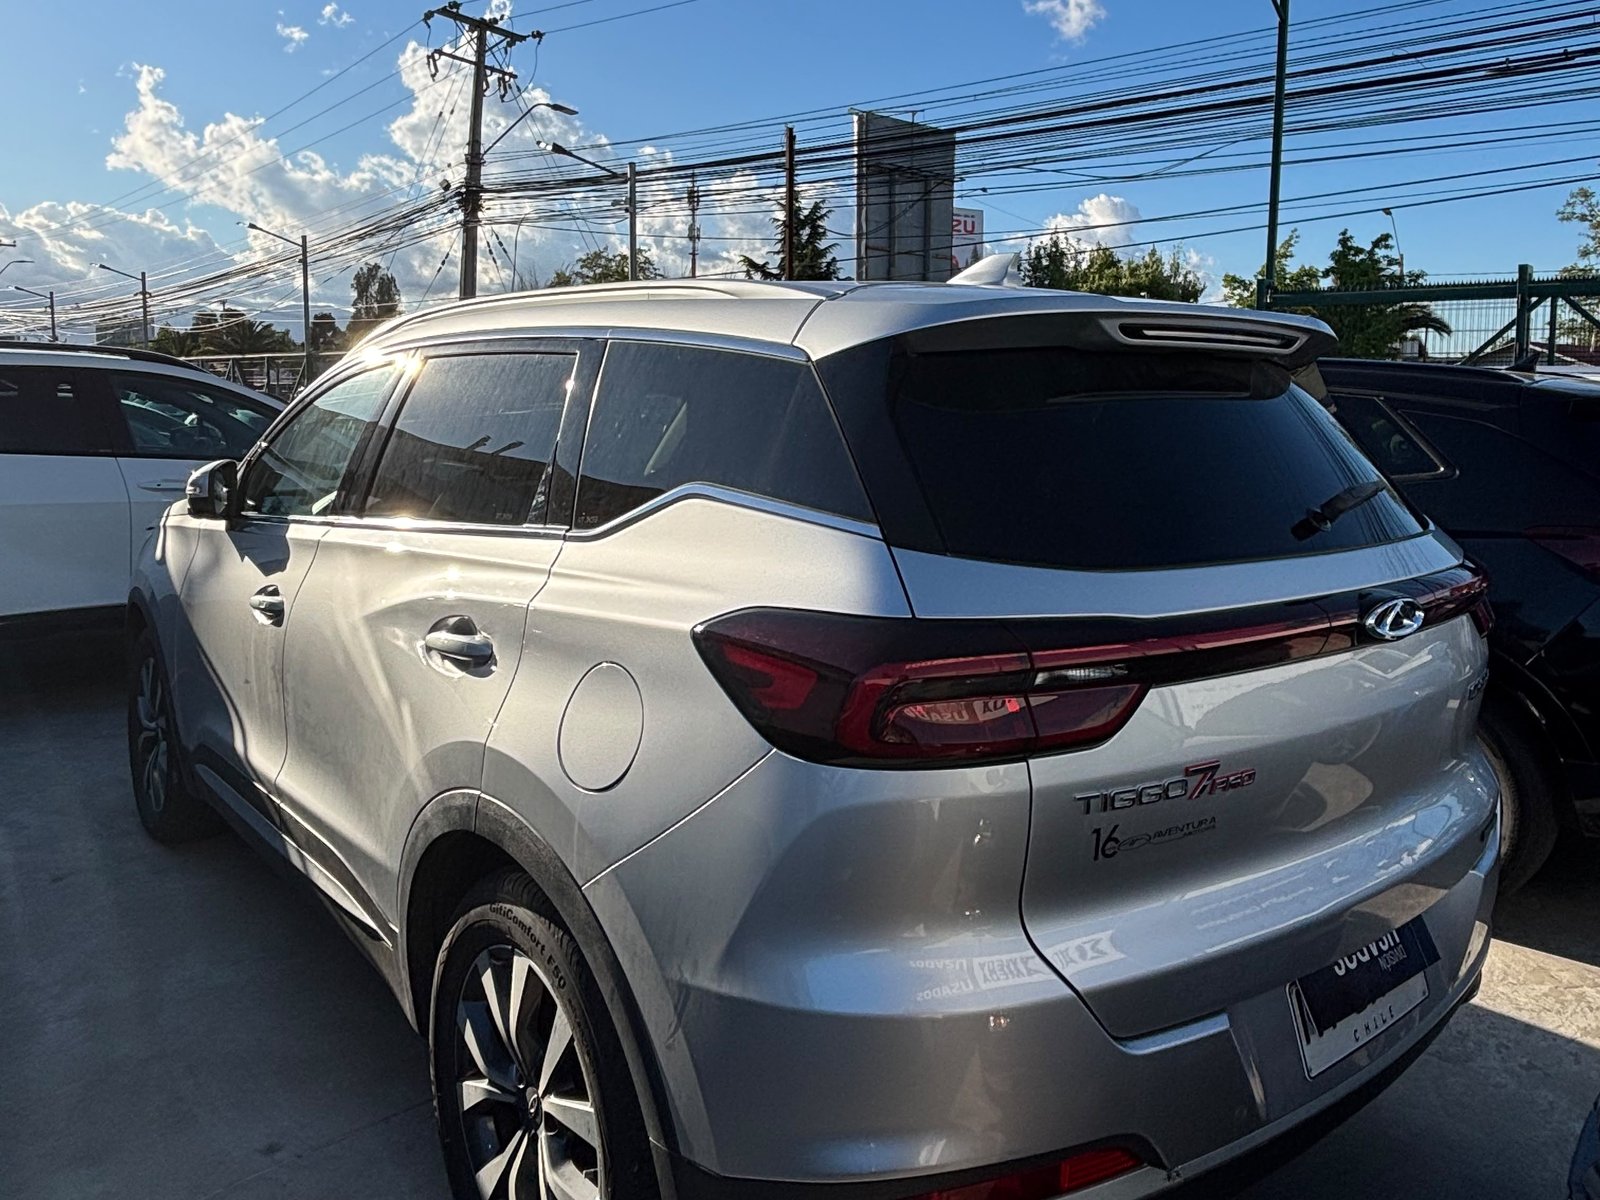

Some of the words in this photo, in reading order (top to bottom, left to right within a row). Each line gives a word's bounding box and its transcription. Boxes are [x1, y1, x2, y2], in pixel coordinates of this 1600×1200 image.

[1074, 778, 1187, 814] TIGGO
[1184, 759, 1221, 800] 7
[1091, 824, 1120, 861] 16
[1153, 816, 1216, 839] AVENTURA
[489, 903, 546, 955] GitiComfort
[546, 954, 568, 991] F50
[1353, 1004, 1395, 1043] CHILE
